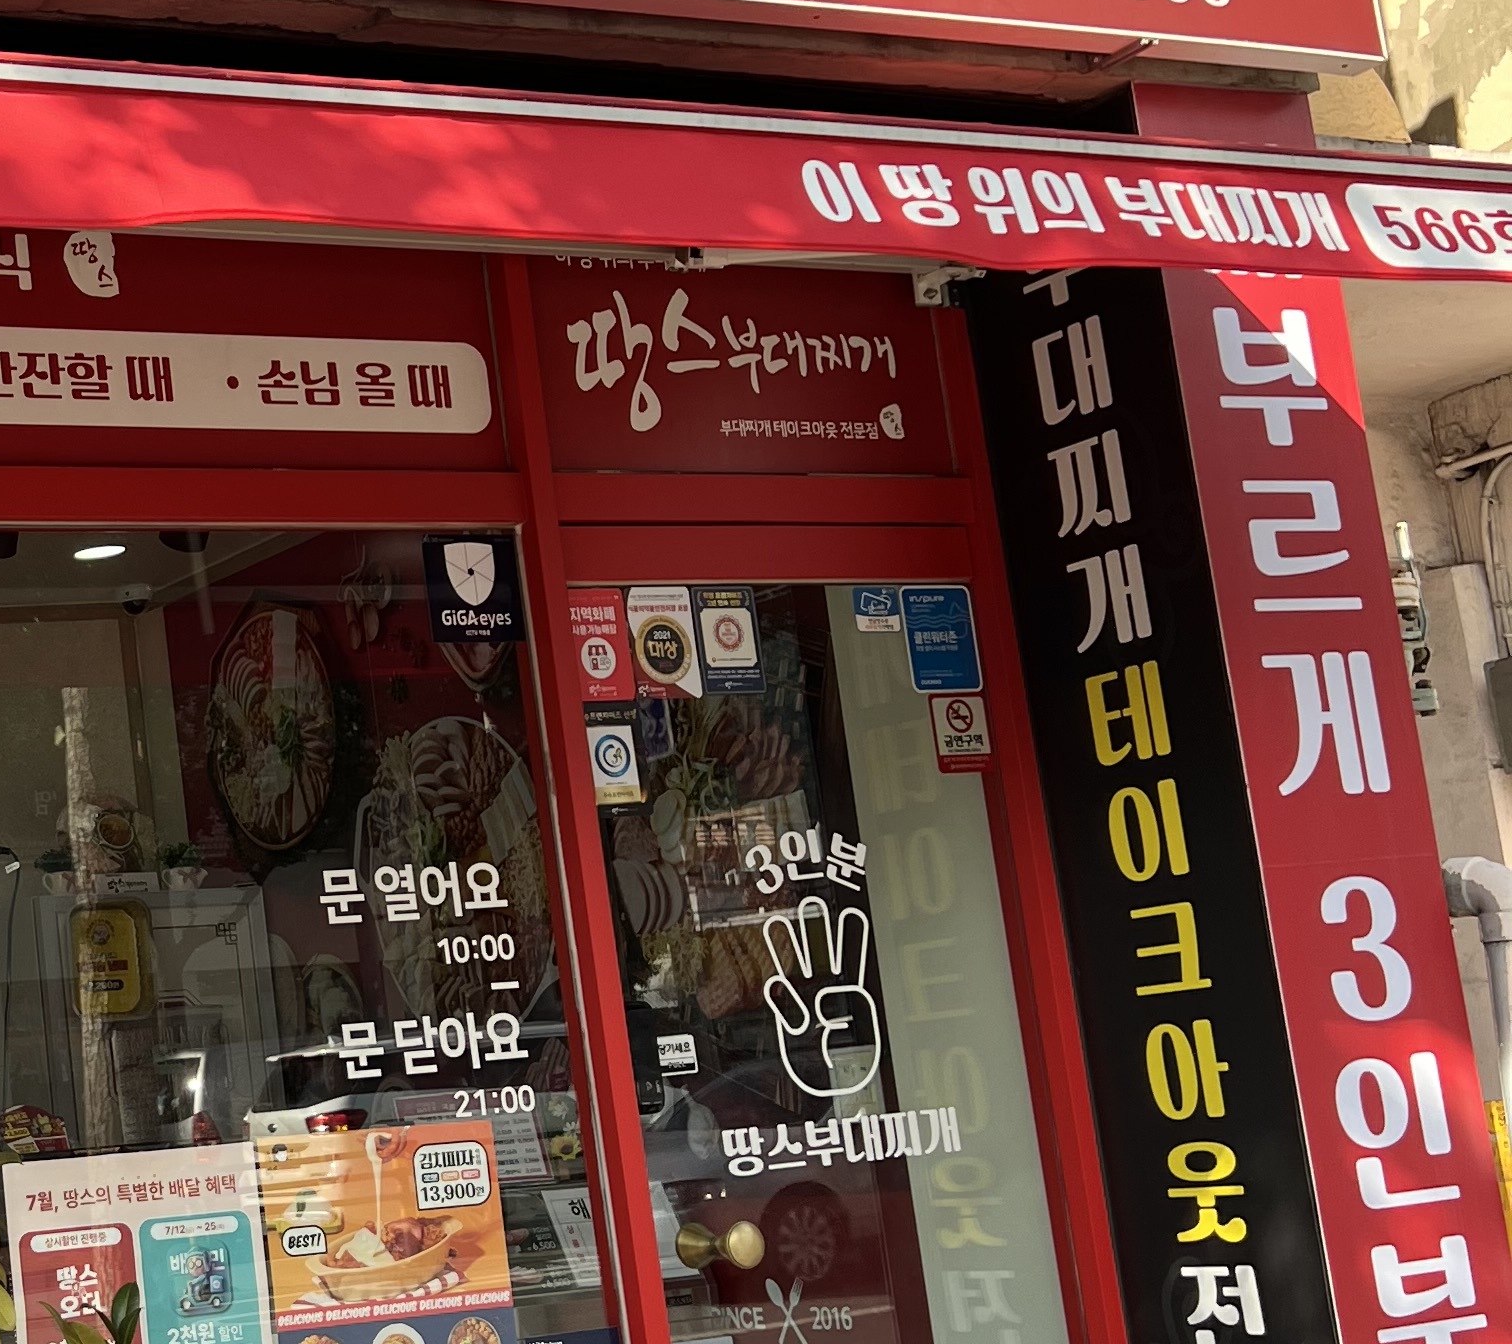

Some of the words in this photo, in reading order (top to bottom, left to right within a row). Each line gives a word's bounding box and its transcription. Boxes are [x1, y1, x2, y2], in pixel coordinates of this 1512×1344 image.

[800, 159, 882, 224] 이
[887, 164, 962, 228] 땅
[968, 165, 1106, 235] 위의
[1105, 175, 1351, 253] 부대찌개
[126, 356, 175, 403] 때
[256, 360, 342, 408] 손님
[353, 362, 397, 409] 올
[407, 363, 453, 409] 때
[719, 418, 772, 438] 부대찌개
[772, 419, 838, 439] 테이크아웃
[839, 421, 880, 440] 전문점
[646, 640, 678, 660] 대상
[943, 733, 984, 748] 금연구역
[744, 827, 868, 895] 3인분
[319, 868, 366, 925] 문
[373, 861, 509, 923] 열어요
[436, 933, 516, 965] 10:00
[338, 1021, 385, 1080] 문
[393, 1011, 529, 1076] 닫아요
[453, 1084, 536, 1118] 21:00
[721, 1106, 963, 1177] 땅스부대찌개
[418, 1148, 475, 1171] 김치피자
[63, 1185, 112, 1209] 땅스의
[116, 1180, 165, 1204] 특별한
[168, 1176, 201, 1200] 배달
[204, 1173, 237, 1196] 혜택
[287, 1232, 321, 1250] BEST!
[55, 1263, 99, 1292] 땅스
[277, 1310, 324, 1327] DELICIOUS
[325, 1305, 371, 1322] DELICIOUS
[372, 1300, 417, 1317] DELICIOUS
[419, 1295, 464, 1312] DELICIOUS
[464, 1289, 511, 1307] DELICIOUS
[809, 1306, 853, 1331] 2016
[217, 1324, 245, 1342] 할인
